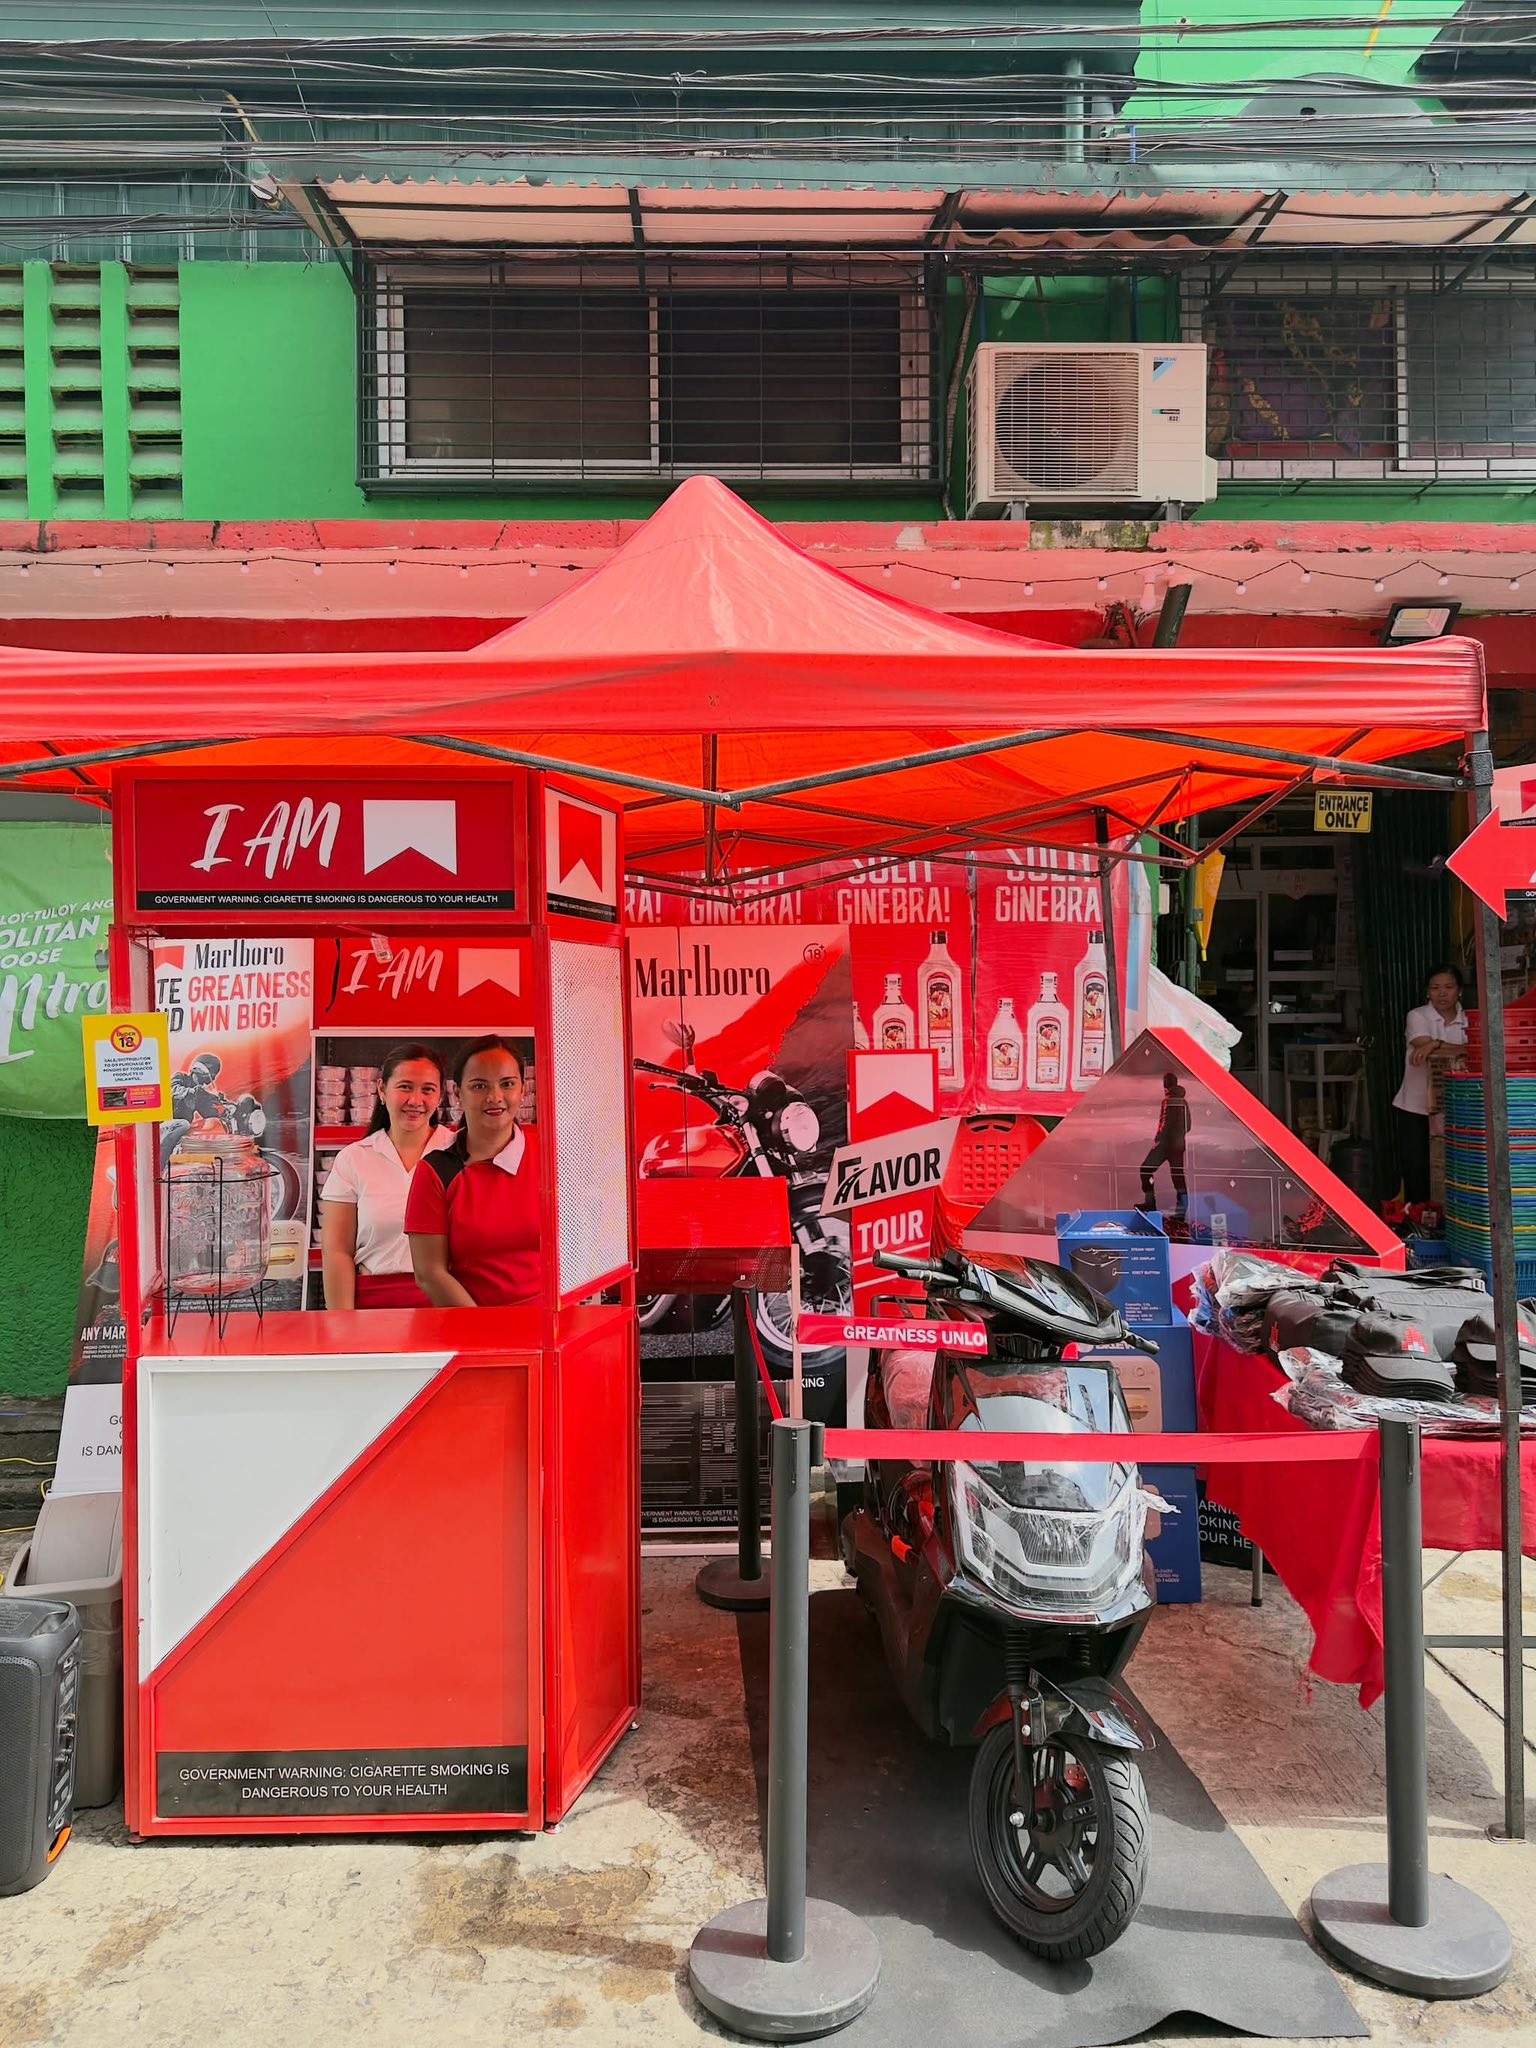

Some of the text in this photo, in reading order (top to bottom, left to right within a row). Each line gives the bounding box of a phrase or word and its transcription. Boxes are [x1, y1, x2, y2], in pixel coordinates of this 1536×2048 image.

[1318, 795, 1369, 812] ENTRANCE
[1325, 812, 1361, 829] ONLY
[190, 796, 342, 880] I AM
[80, 899, 114, 912] ANG
[154, 895, 499, 904] GOVERNMENT WARNING: CIGARETTE SMOKING IS DANGEROUS TO YOUR HEALTH
[689, 888, 802, 925] GINEBRA!
[837, 888, 951, 925] GINEBRA!
[194, 939, 285, 970] Marlboro
[377, 945, 445, 1000] AM
[634, 944, 771, 998] Marlboro
[188, 970, 312, 1003] GREATNESS
[190, 1005, 231, 1033] WIN
[236, 1001, 280, 1031] BIG!
[119, 1037, 135, 1048] 18
[833, 1147, 942, 1206] FLAVOR
[857, 1209, 924, 1254] TOUR
[81, 1326, 126, 1341] ANY MAR
[843, 1325, 937, 1344] GREATNESS
[81, 1445, 123, 1456] IS DAN
[1198, 1514, 1242, 1532] OKING
[1198, 1530, 1253, 1549] OUR HE
[179, 1763, 510, 1780] GOVERNMENT WARNING: CIGARETTE SMOKING IS
[242, 1783, 448, 1799] DANGEROUS TO YOUR HEALTH
